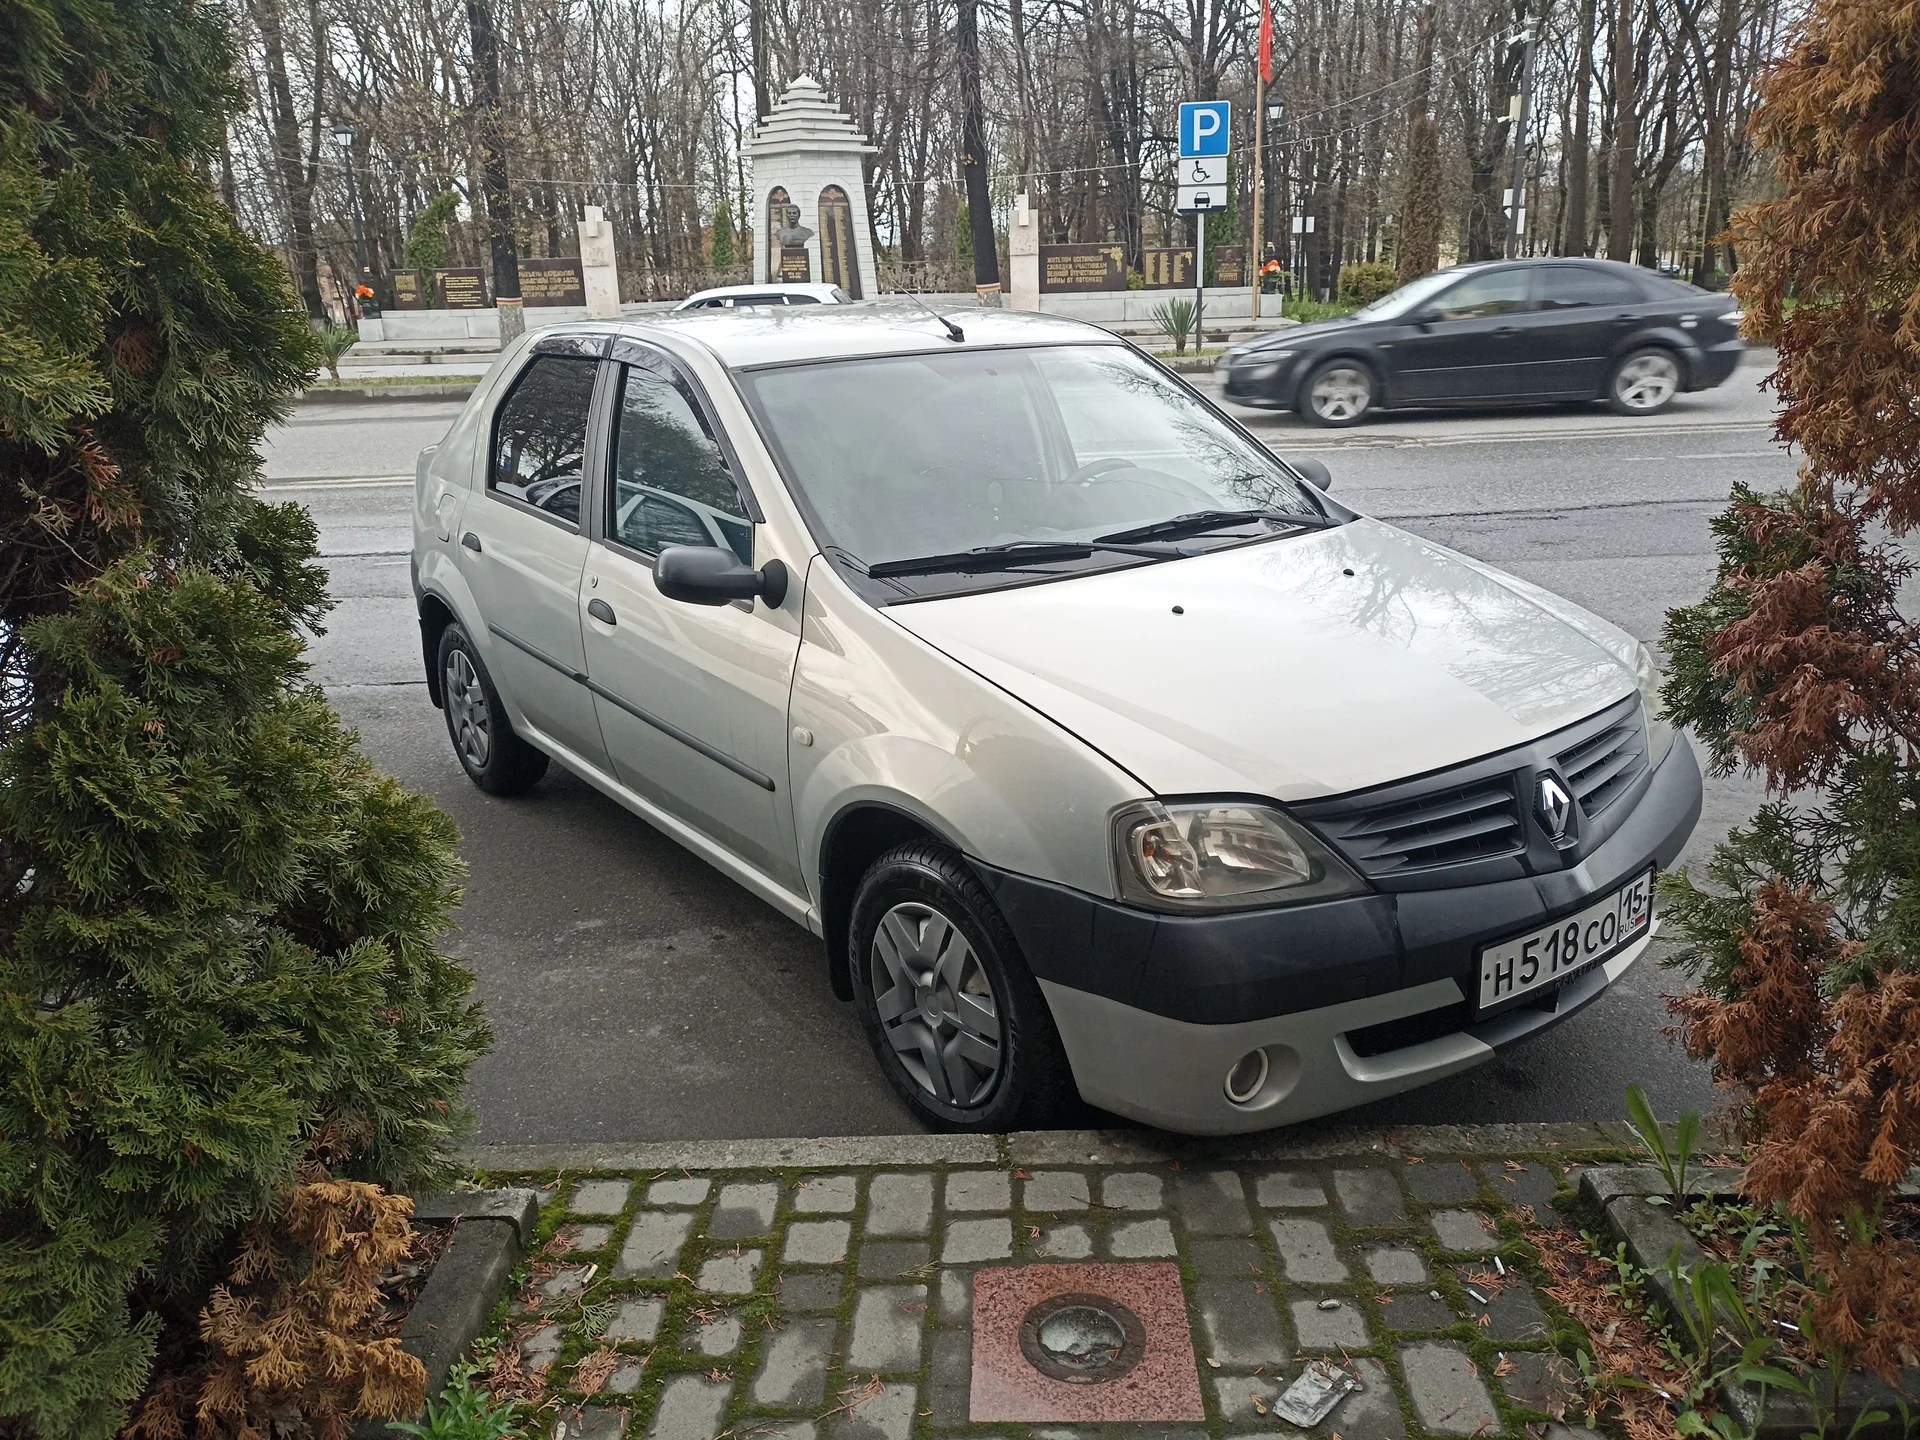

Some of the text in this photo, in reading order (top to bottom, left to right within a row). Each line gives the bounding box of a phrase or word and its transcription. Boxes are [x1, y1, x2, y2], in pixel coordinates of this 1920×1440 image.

[1193, 108, 1221, 152] P
[1622, 880, 1645, 920] 15
[1619, 917, 1635, 936] RUS
